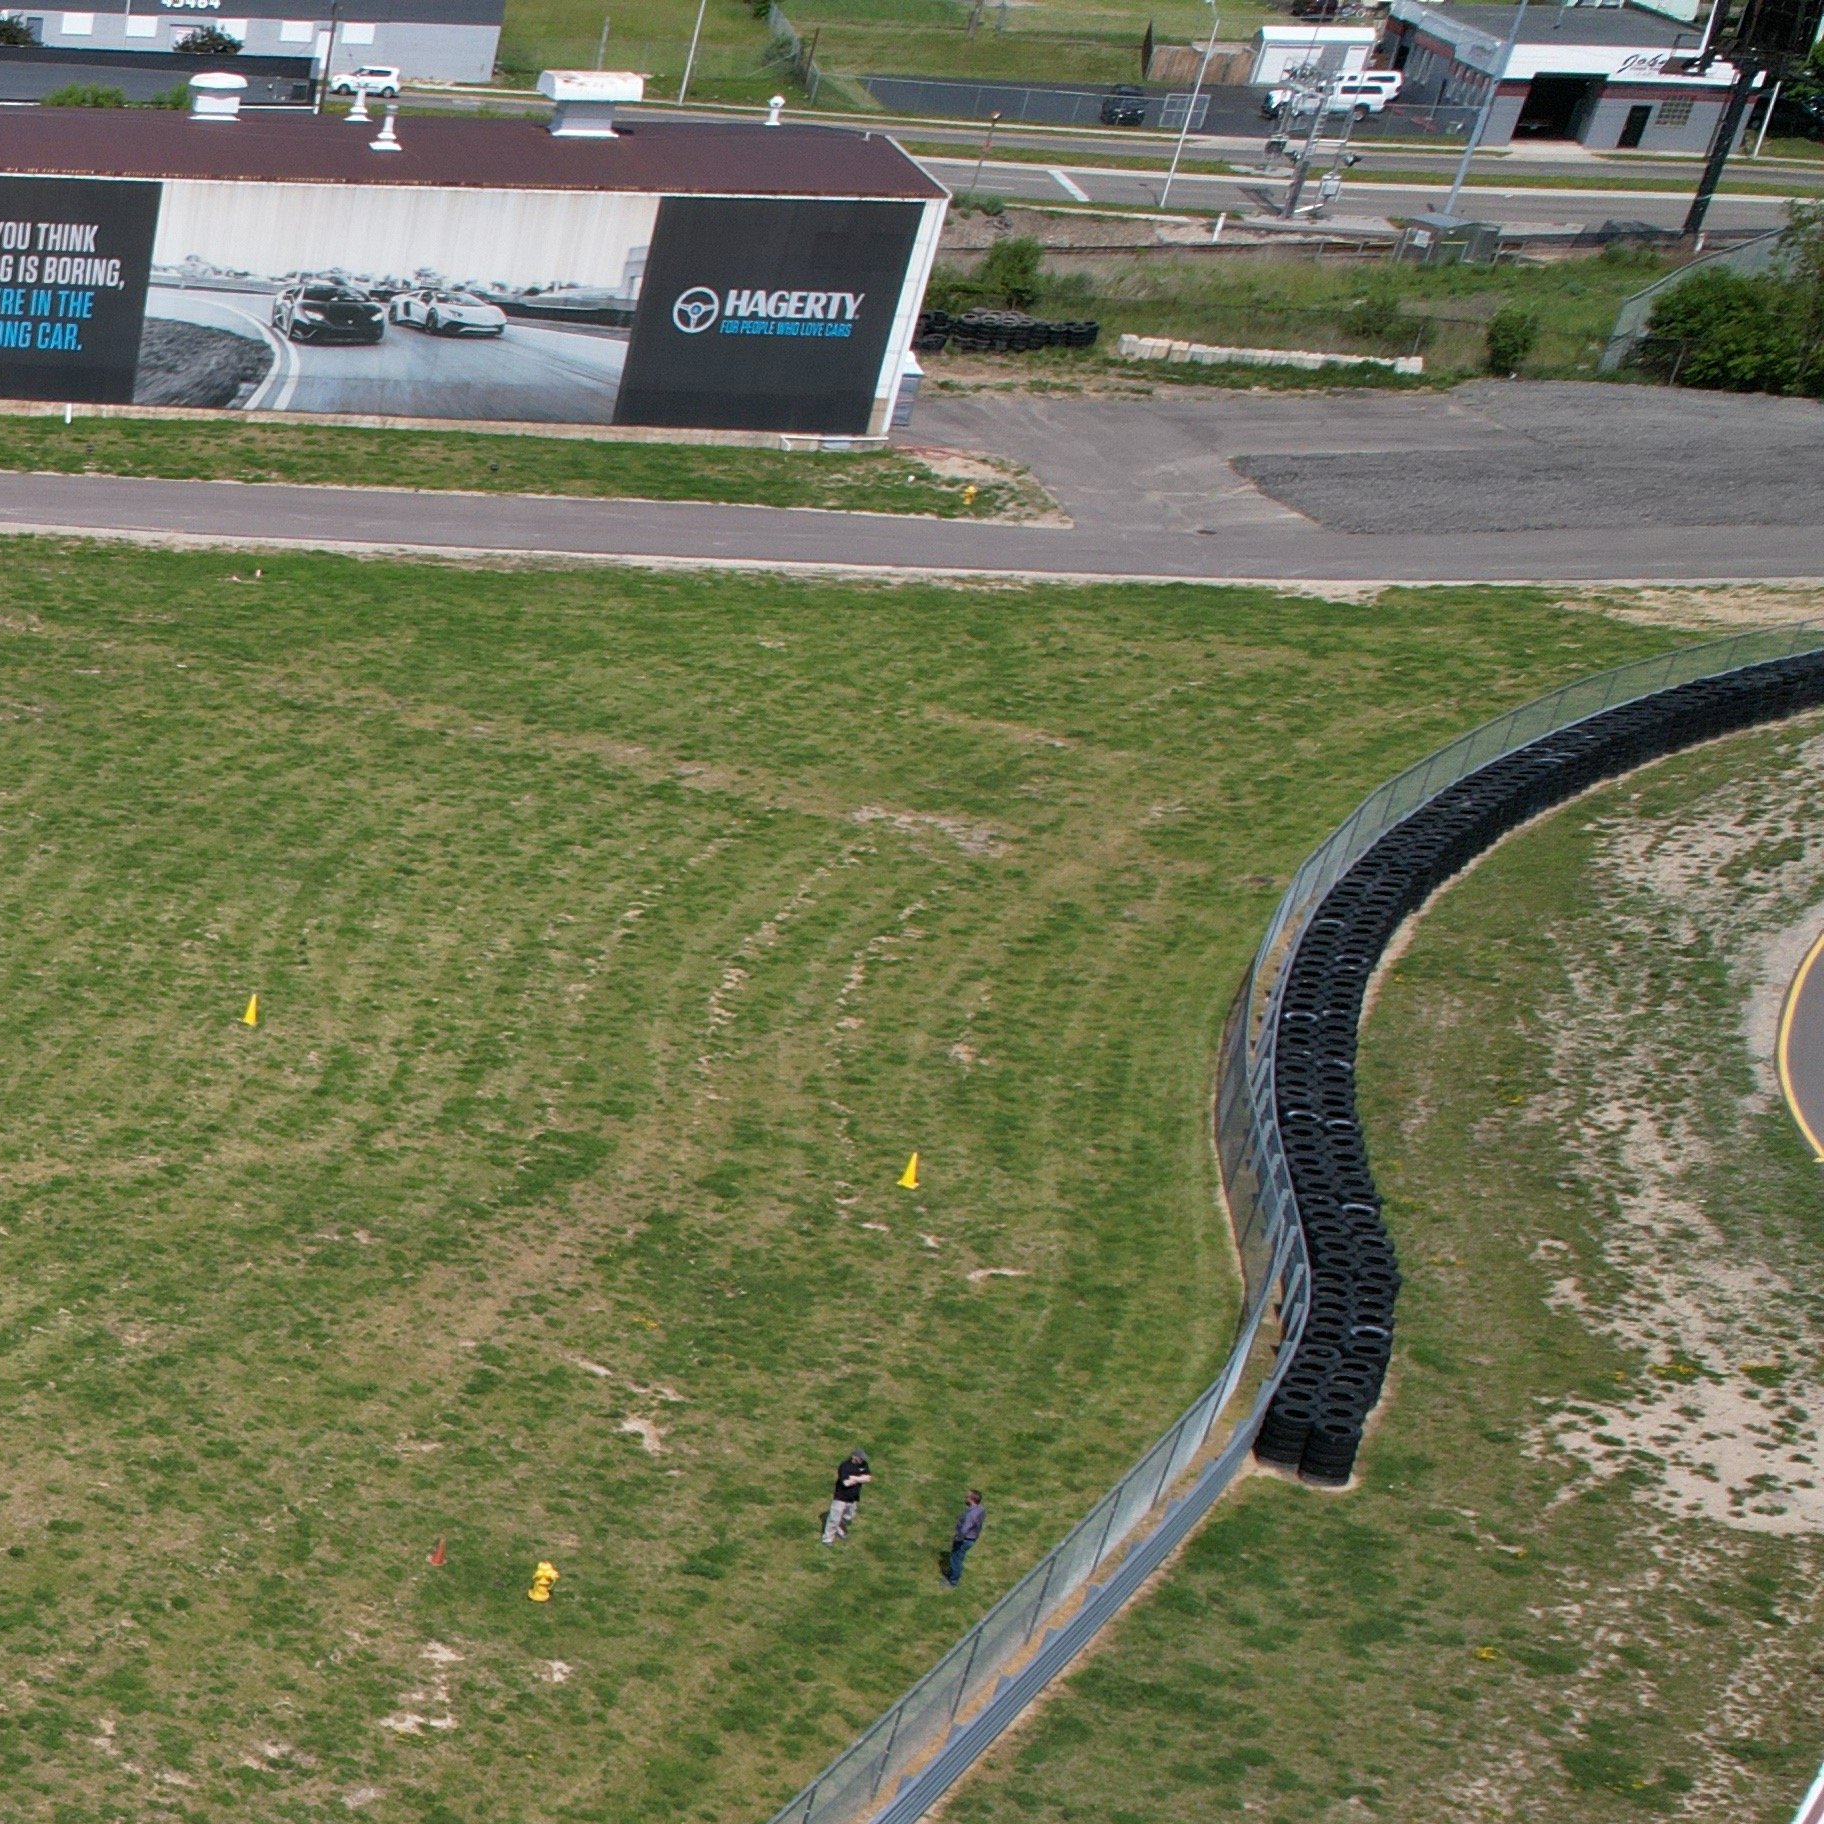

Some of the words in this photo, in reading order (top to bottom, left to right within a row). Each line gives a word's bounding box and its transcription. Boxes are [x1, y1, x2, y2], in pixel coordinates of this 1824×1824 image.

[36, 223, 99, 252] THINK
[17, 255, 39, 284] IS
[42, 257, 125, 290] BORING,
[30, 289, 52, 316] IN
[57, 290, 95, 318] THE
[723, 289, 865, 319] HAGERTY
[36, 322, 83, 351] CAR.
[720, 320, 738, 333] FOR
[740, 320, 775, 335] PEOPLE
[776, 321, 800, 336] WHO
[801, 322, 825, 336] LOVE
[826, 323, 852, 337] CARS
